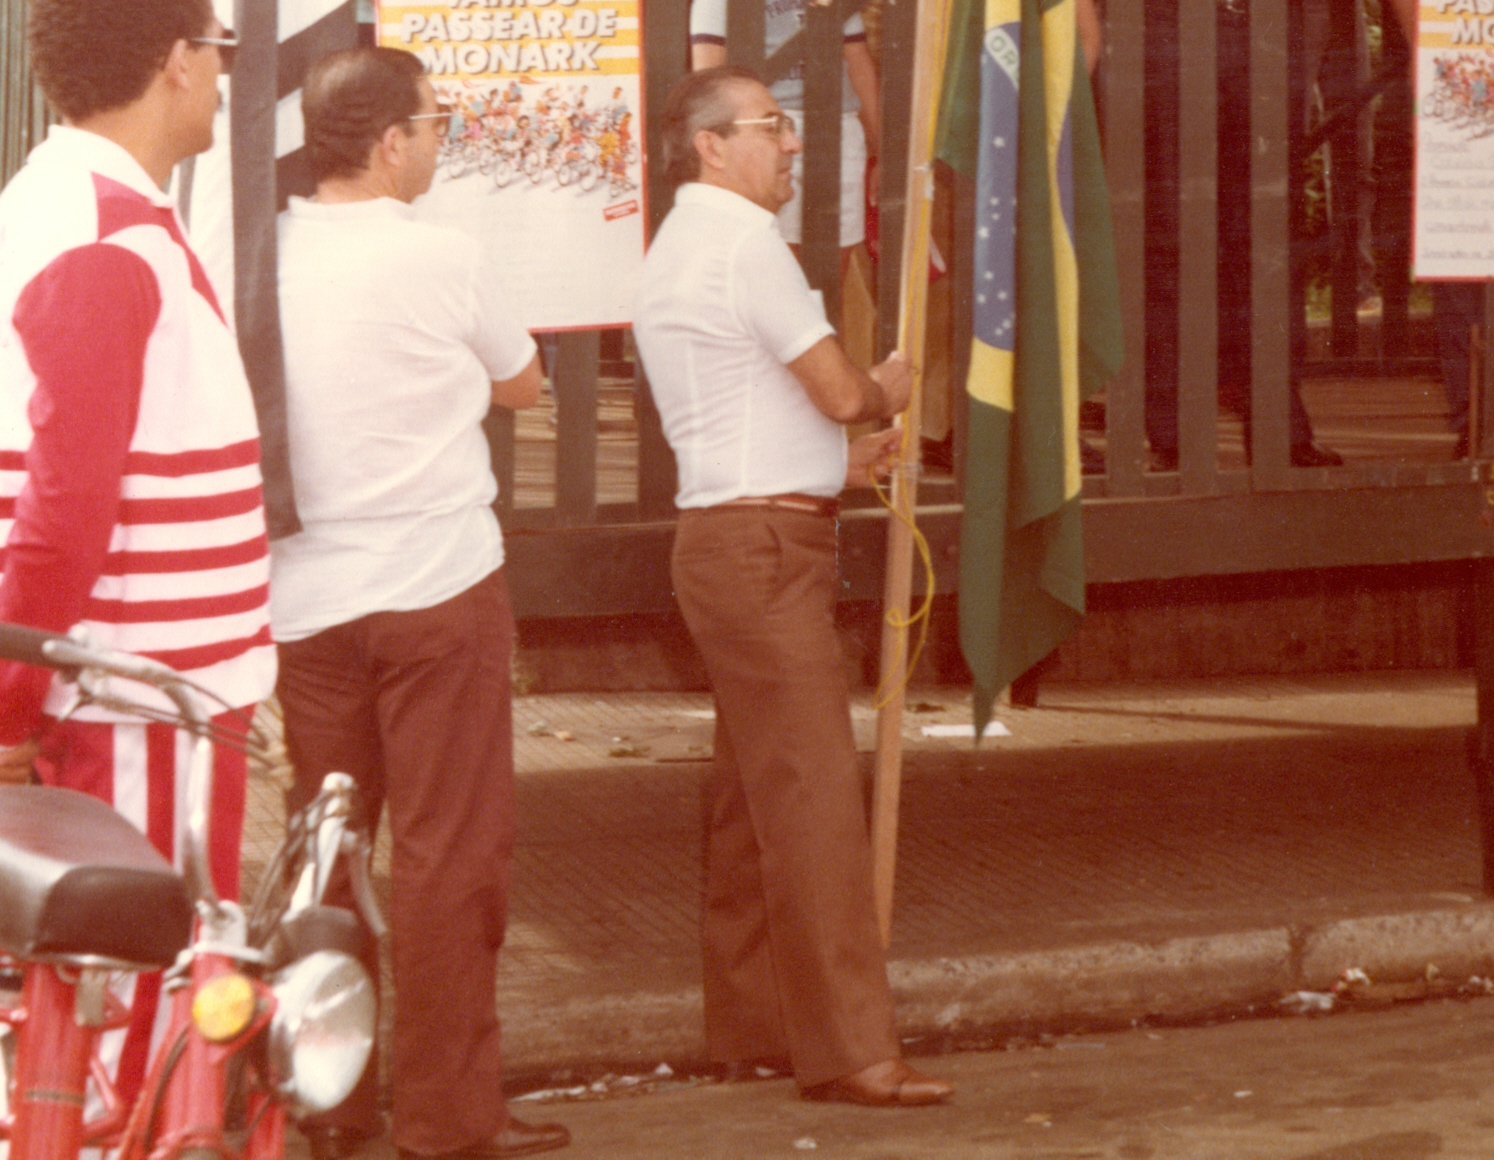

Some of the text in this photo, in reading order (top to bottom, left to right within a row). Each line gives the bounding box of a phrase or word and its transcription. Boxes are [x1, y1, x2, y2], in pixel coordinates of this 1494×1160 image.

[400, 8, 618, 43] PASSEAR DE
[423, 41, 601, 75] MONARK
